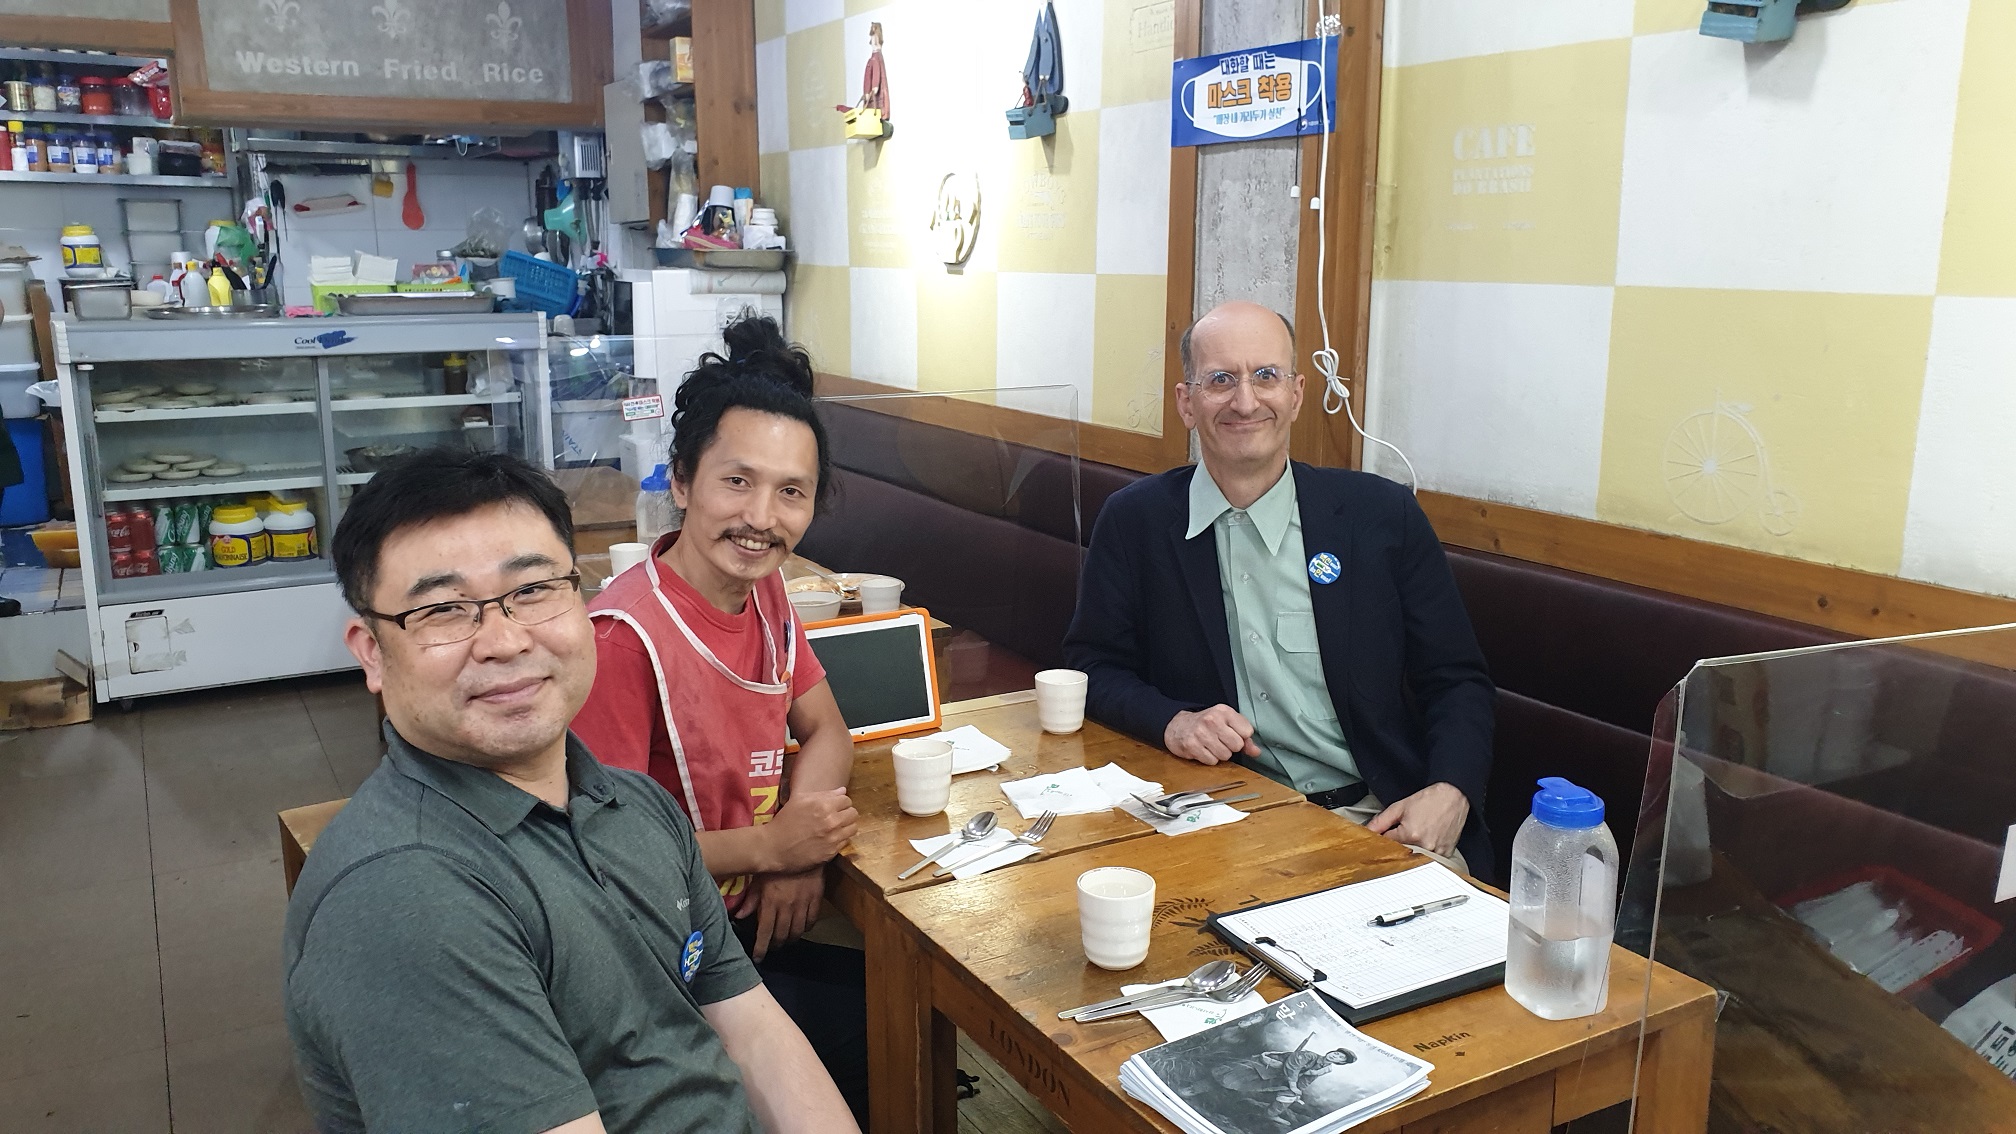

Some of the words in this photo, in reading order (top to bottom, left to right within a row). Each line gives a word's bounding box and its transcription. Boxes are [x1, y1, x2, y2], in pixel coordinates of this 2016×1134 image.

[235, 50, 360, 77] Western
[383, 58, 457, 81] Fried
[482, 62, 544, 84] Rice
[1220, 54, 1250, 76] 대화할
[1253, 51, 1276, 71] 때는
[1207, 77, 1252, 109] 마스크
[1258, 72, 1292, 103] 착용
[295, 336, 316, 345] Cool
[221, 546, 236, 554] GOLD
[1413, 1030, 1471, 1053] Napkin
[989, 1018, 1071, 1108] LONDON
